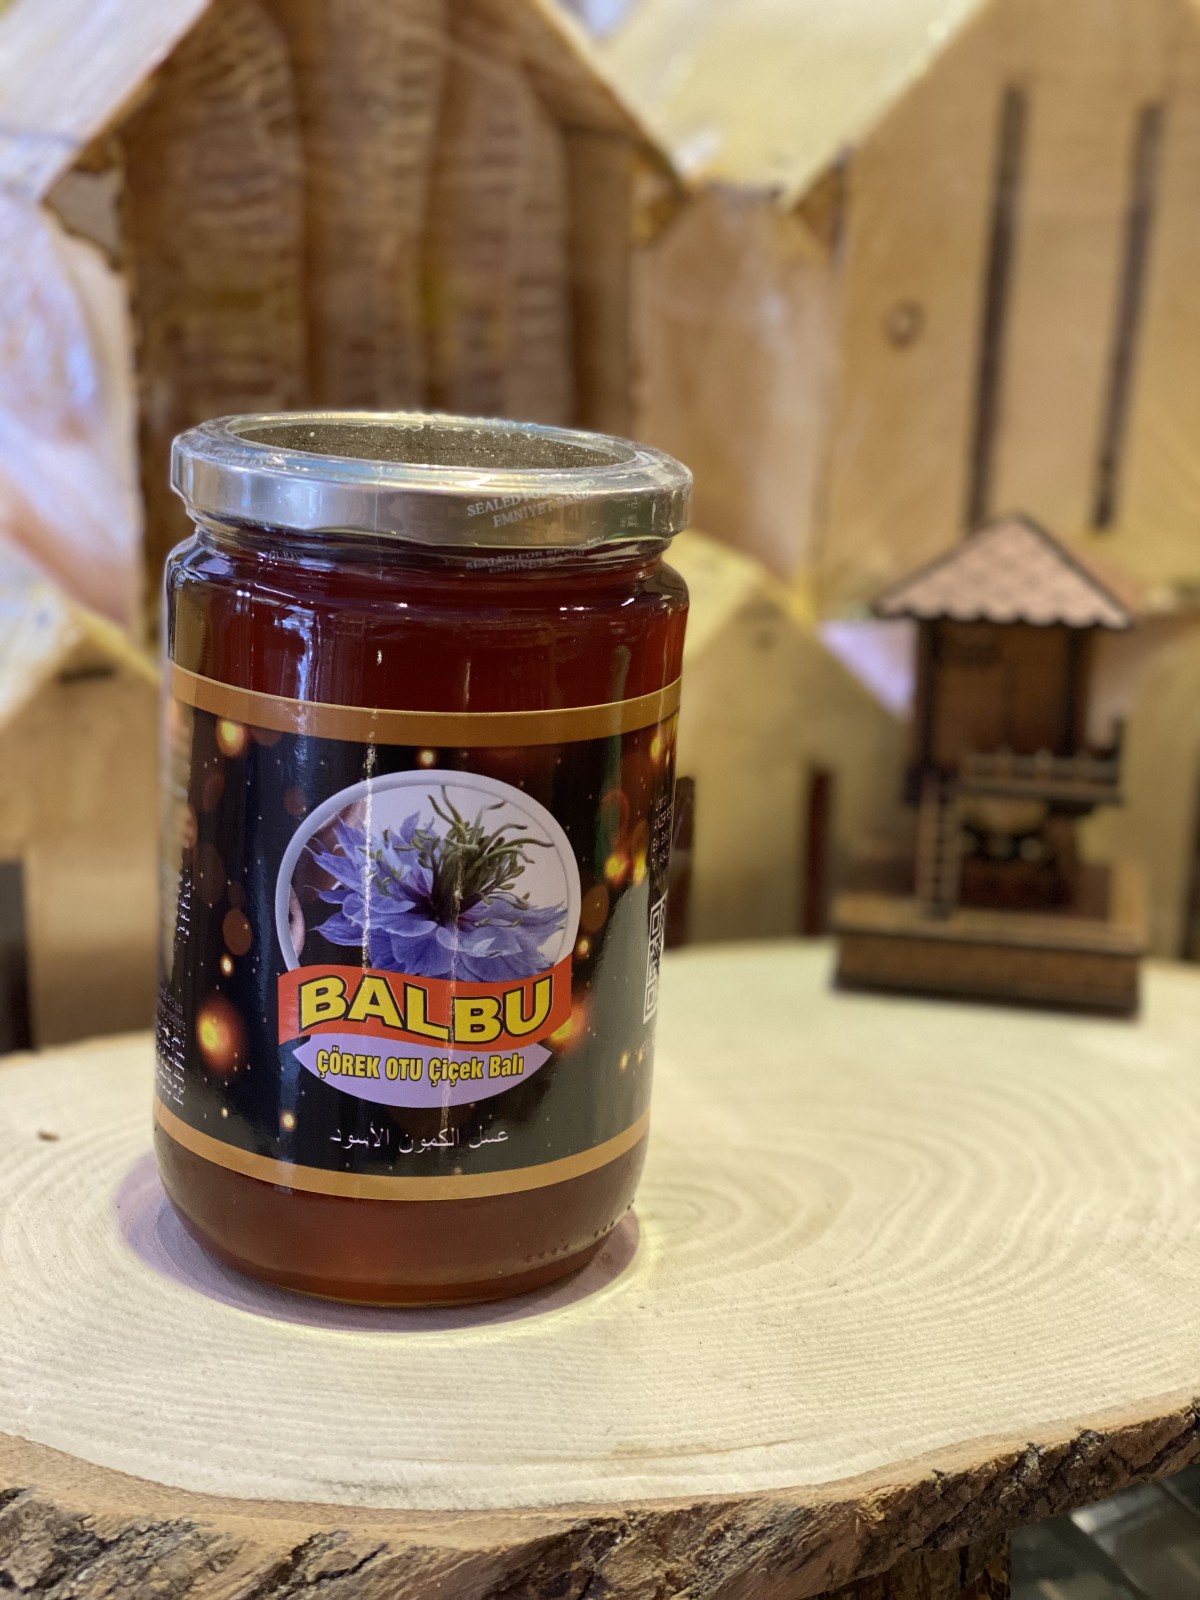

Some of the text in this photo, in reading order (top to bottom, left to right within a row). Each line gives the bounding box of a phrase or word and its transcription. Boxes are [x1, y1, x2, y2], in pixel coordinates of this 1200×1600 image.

[467, 494, 521, 517] SEALED
[518, 551, 544, 560] FOR
[299, 974, 554, 1045] BALBU
[317, 1046, 524, 1087] ÇÖREK OTU Çiçek Balı
[399, 1127, 460, 1154] الكمون
[468, 1125, 509, 1149] عسل
